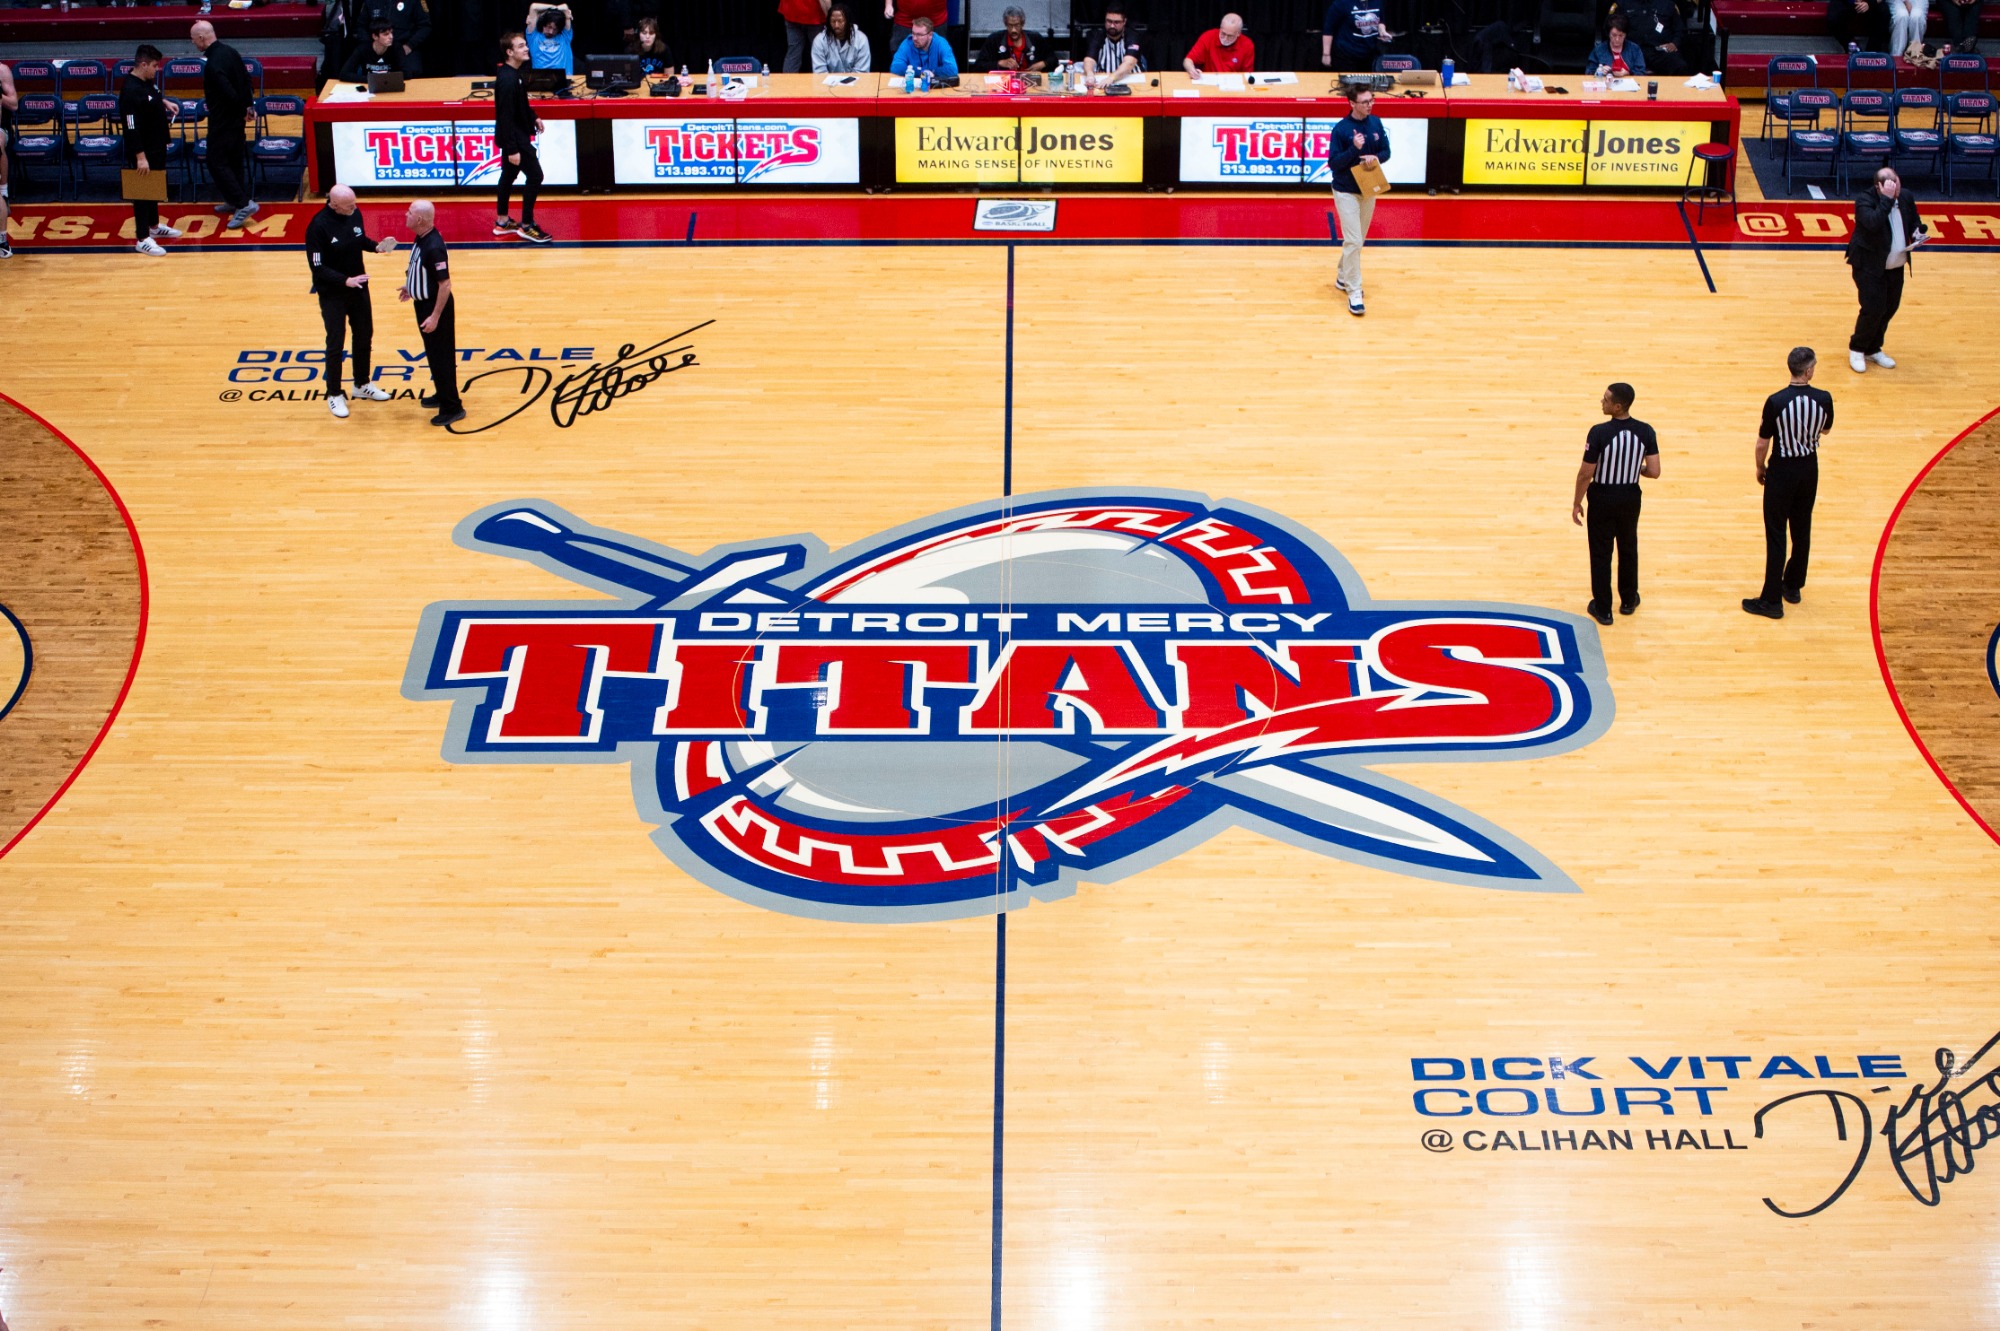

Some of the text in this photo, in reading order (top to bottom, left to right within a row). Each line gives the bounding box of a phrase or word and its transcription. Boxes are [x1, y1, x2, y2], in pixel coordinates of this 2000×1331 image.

[1777, 62, 1807, 70] TITANS
[1856, 58, 1887, 66] TITANS
[1949, 60, 1979, 68] TITANS
[19, 67, 48, 75] TITANS
[68, 66, 97, 75] TITANS
[171, 65, 201, 73] TITANS
[722, 63, 752, 72] TITANS
[1799, 95, 1830, 104] TITANS
[1902, 95, 1932, 103] TITANS
[1959, 98, 1989, 107] TITANS
[25, 101, 54, 109] TITANS
[86, 101, 115, 109] TITANS
[266, 102, 295, 110] TITANS
[406, 126, 495, 134] DetroitTitans.co
[916, 126, 1114, 154] Edward Jones
[1484, 128, 1681, 157] Edward Jones
[1216, 128, 1332, 162] TICKE
[367, 132, 502, 168] TICKET
[918, 160, 1113, 169] MAKING SENSE OF INVESTING
[1485, 162, 1679, 172] MAKING SENSE OF INVESTING
[378, 168, 465, 178] 313.993.1700
[657, 166, 745, 176] 313.993.1700
[1222, 165, 1311, 175] 313.993.1700
[397, 347, 596, 362] VTALE
[219, 388, 244, 403] @
[248, 389, 369, 401] CALIH
[699, 612, 1333, 633] DETROIT MERCY
[445, 617, 1575, 745] TITANS
[1410, 1054, 1908, 1081] DICK VITALE
[1412, 1086, 1729, 1117] COURT
[1421, 1128, 1749, 1153] @ CALIHAN HALL
